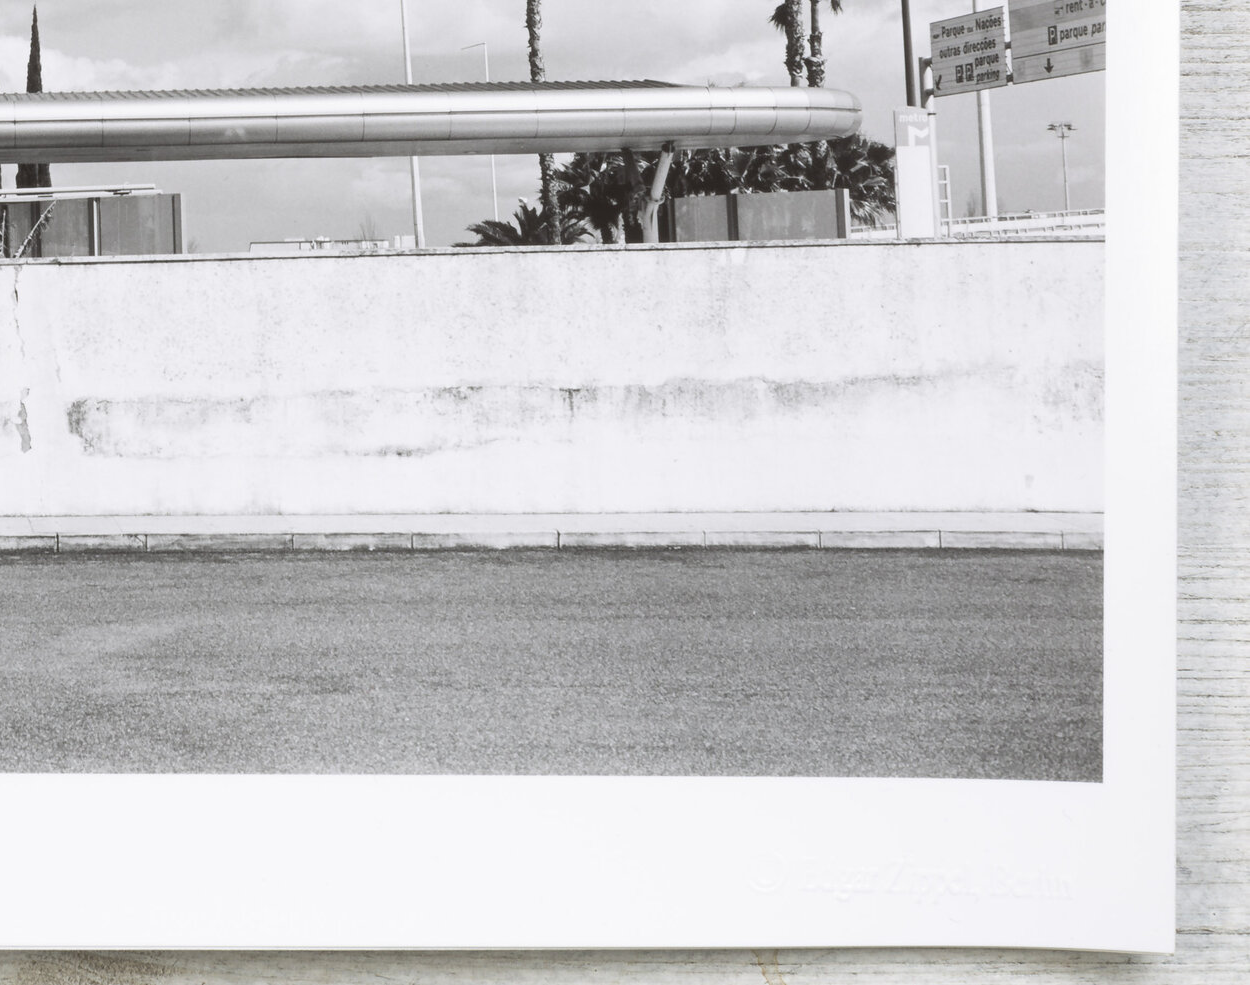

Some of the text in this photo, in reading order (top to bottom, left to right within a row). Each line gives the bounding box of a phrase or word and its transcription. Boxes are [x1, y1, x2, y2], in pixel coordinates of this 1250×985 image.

[941, 25, 965, 38] Parque
[975, 15, 1002, 33] Nações
[1060, 25, 1088, 42] parque
[939, 46, 961, 59] outras
[975, 53, 1000, 70] parque
[976, 68, 1000, 85] parking
[899, 113, 928, 123] metro
